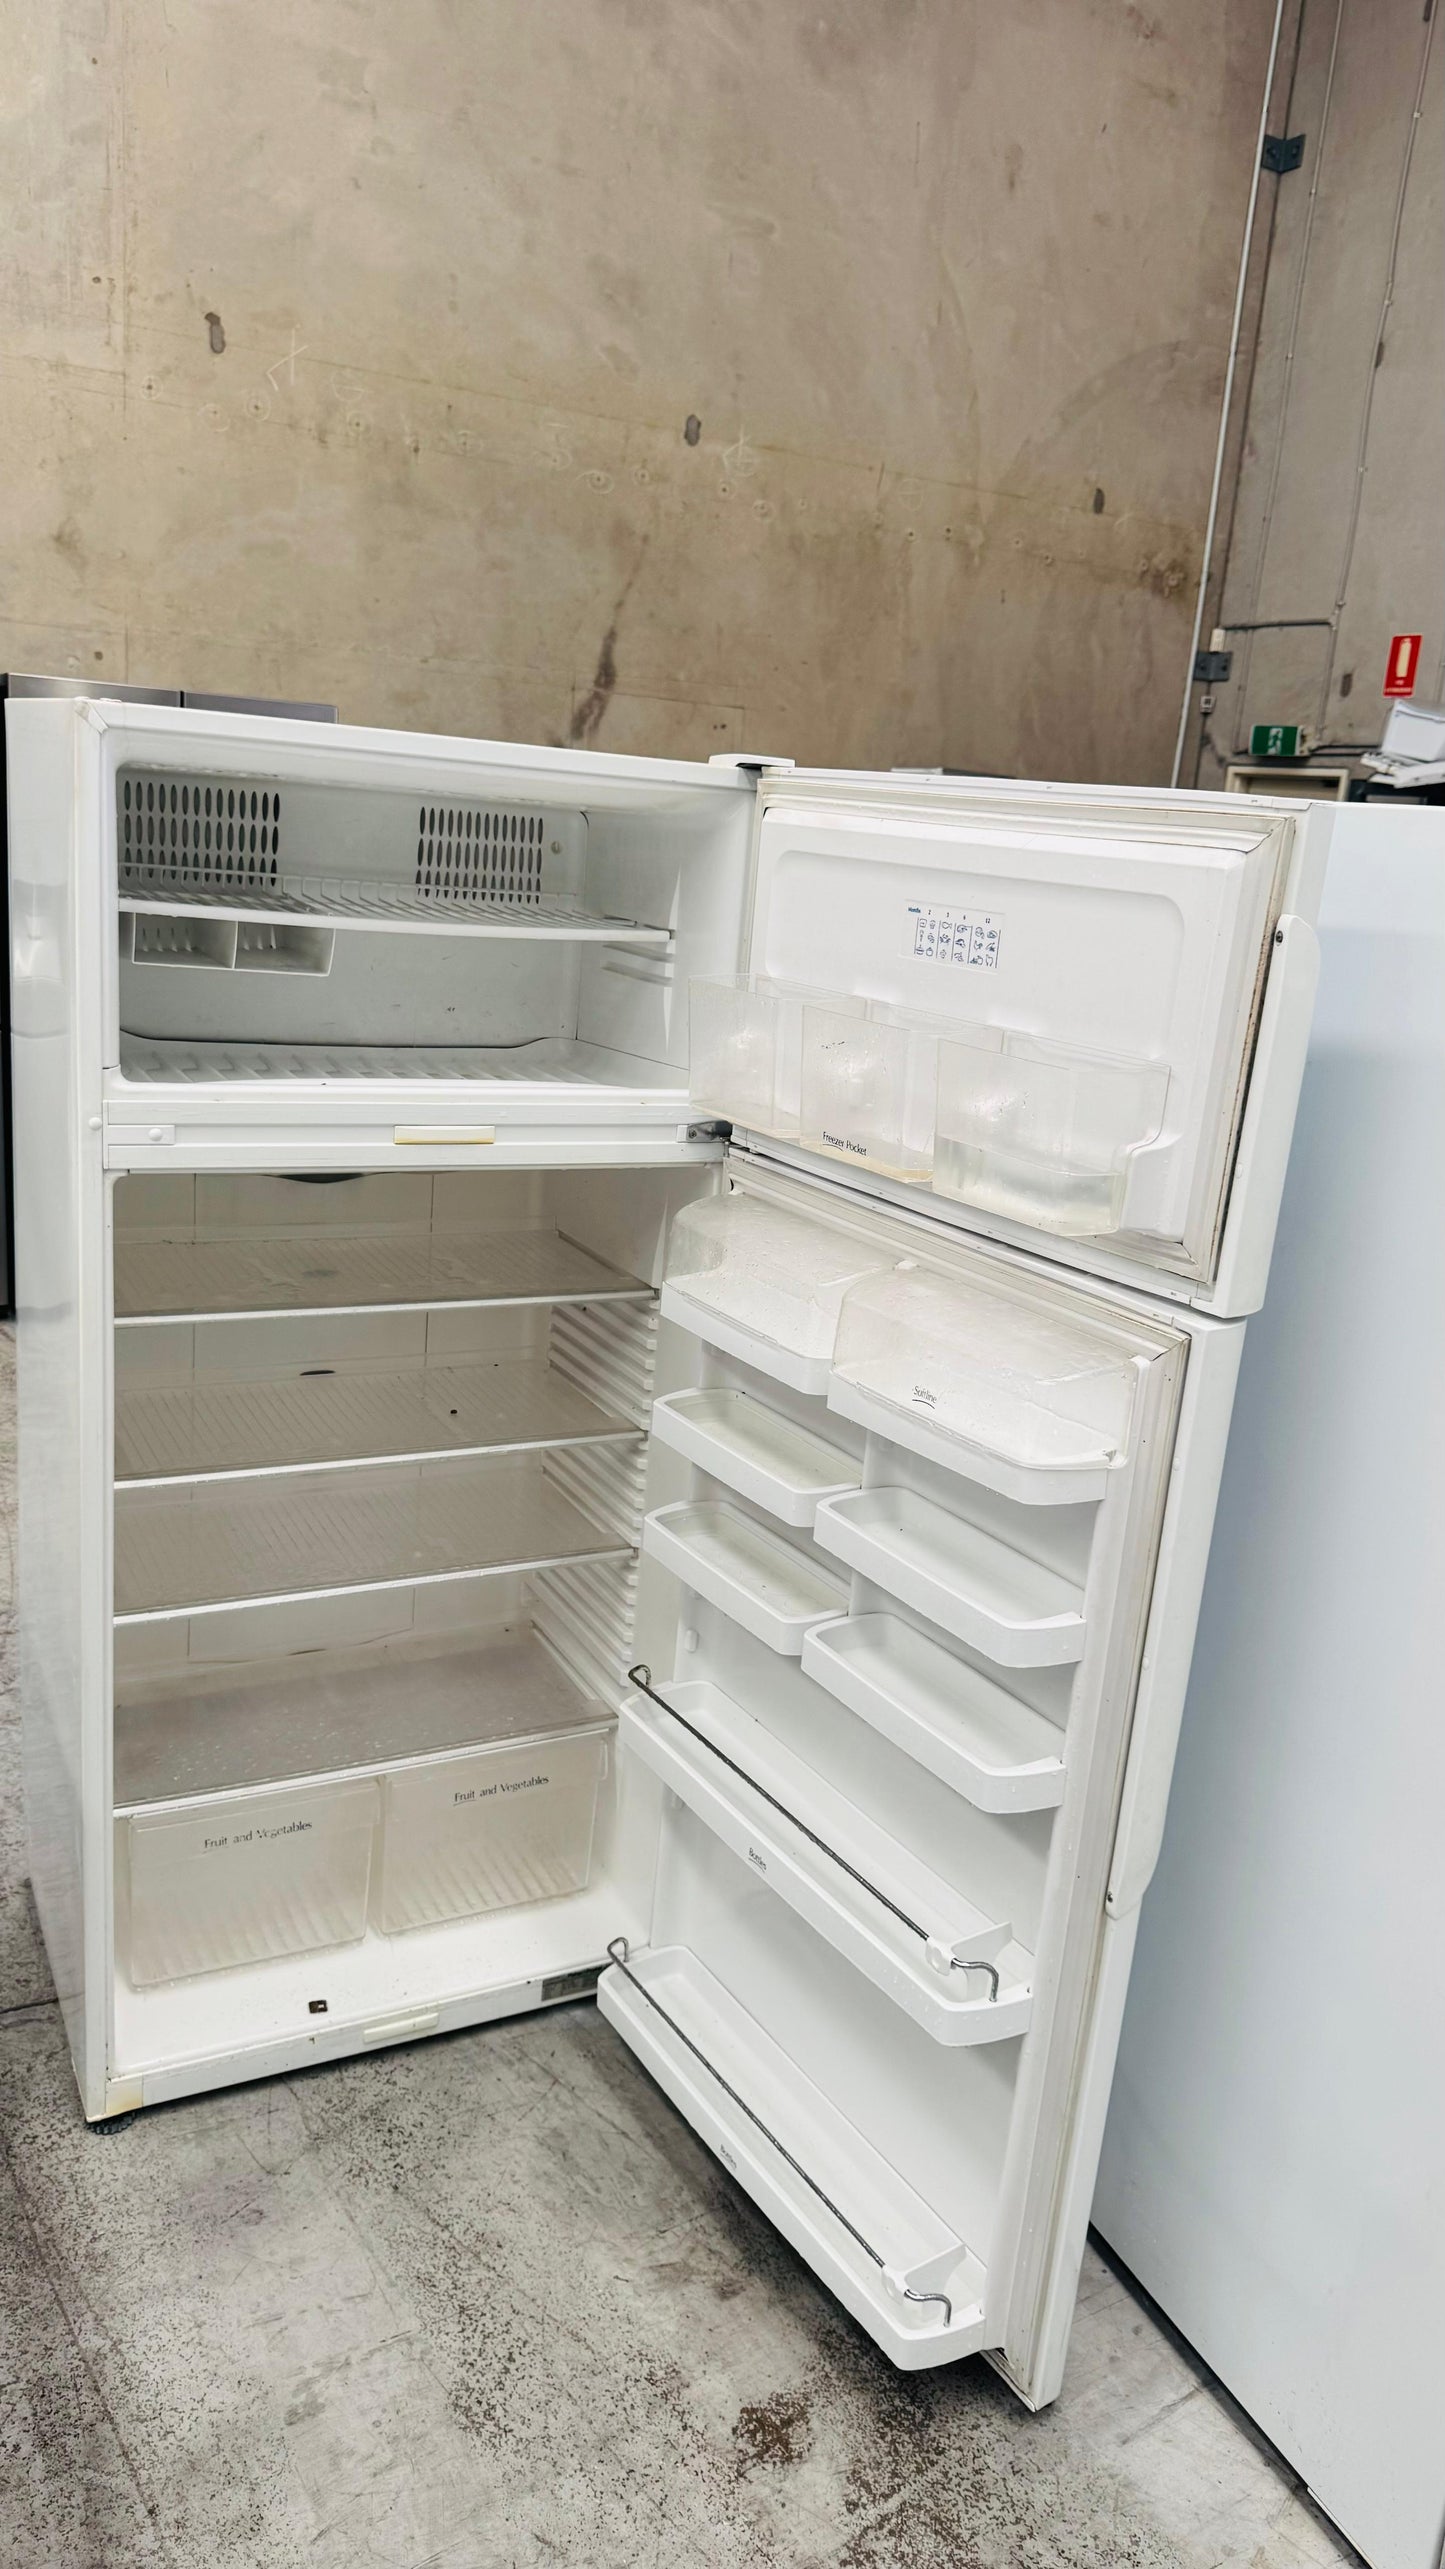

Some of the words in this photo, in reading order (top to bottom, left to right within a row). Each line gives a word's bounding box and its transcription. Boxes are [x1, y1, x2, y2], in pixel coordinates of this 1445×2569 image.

[822, 1131, 844, 1147] Freezer
[846, 1140, 867, 1156] Pocket
[454, 1790, 475, 1802] Fruit
[480, 1784, 497, 1797] and
[500, 1776, 549, 1792] Vegetables
[204, 1836, 228, 1848] Fruit
[233, 1830, 252, 1843] and
